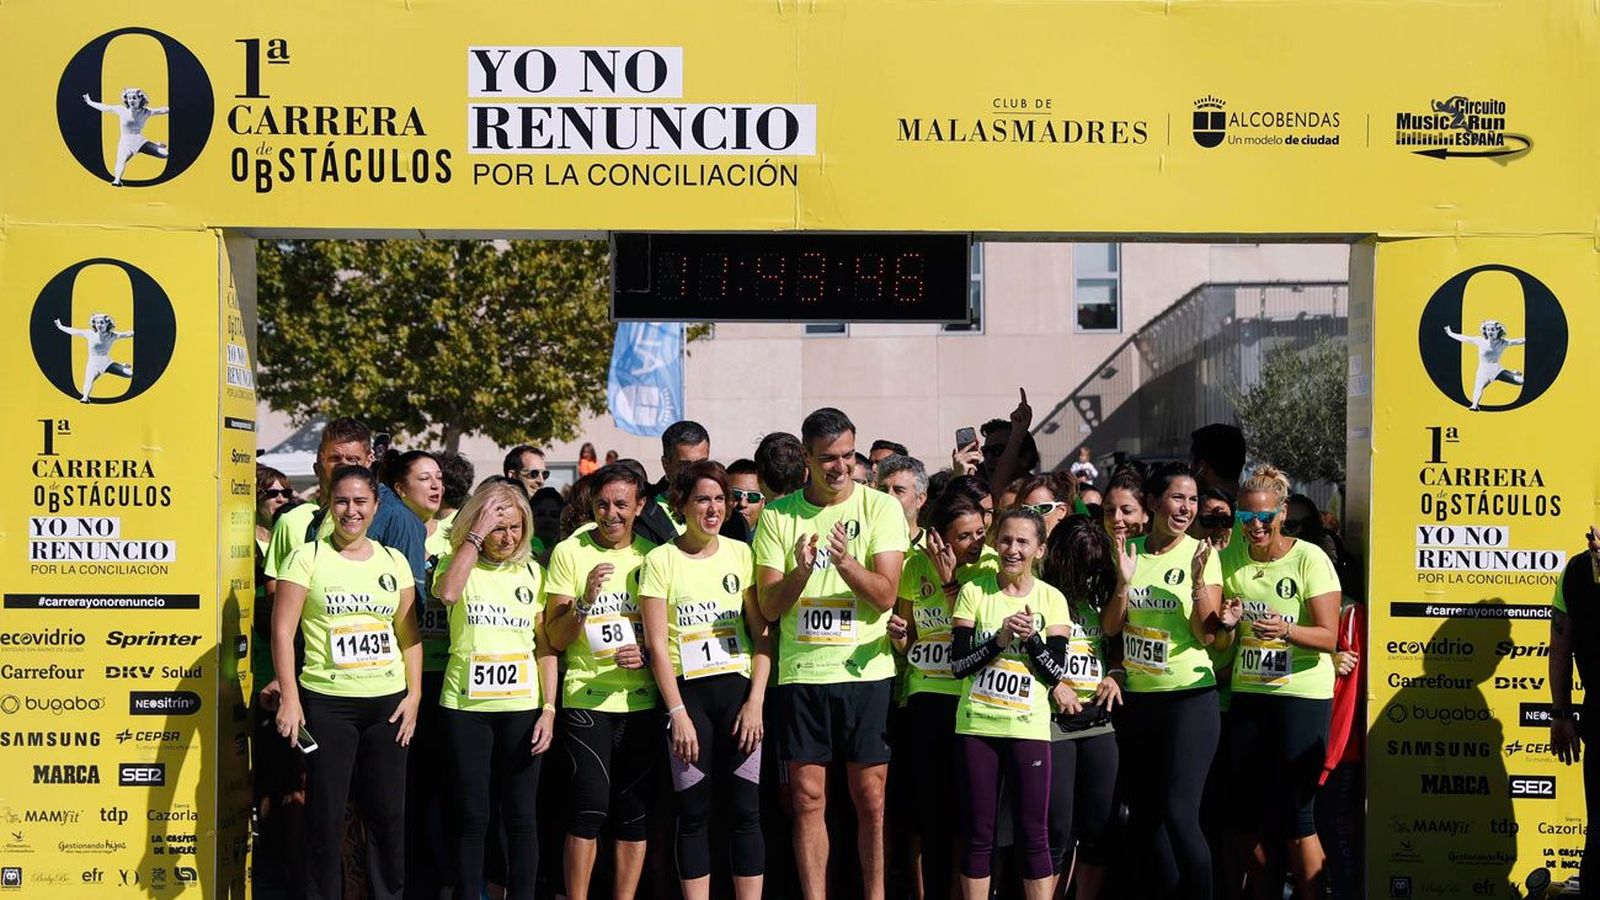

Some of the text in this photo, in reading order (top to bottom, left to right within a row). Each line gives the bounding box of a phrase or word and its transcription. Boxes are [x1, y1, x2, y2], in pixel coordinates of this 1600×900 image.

[470, 49, 668, 93] YO NO
[992, 98, 1052, 109] CLUB DE
[1455, 99, 1506, 115] Circuito
[227, 105, 427, 137] CARRERA
[472, 106, 799, 150] RENUNCIO
[1229, 112, 1340, 128] ALCOBENDAS
[896, 118, 1148, 145] MALASMADRES
[1228, 134, 1340, 145] Un modelo de ciudad
[1455, 131, 1504, 146] ESPAÑA
[256, 141, 272, 156] de
[231, 141, 452, 193] OBSTÁCULOS
[473, 158, 798, 187] POR LA CONCILIACIÓN
[32, 459, 155, 478] CARRERA
[1419, 467, 1545, 487] CARRERA
[33, 481, 171, 514] OBSTÁCULOS
[1421, 490, 1561, 522] OBSTÁCULOS
[31, 518, 114, 537] YO NO
[1418, 526, 1502, 545] YO NO
[31, 541, 169, 561] RENUNCIO
[1418, 550, 1558, 570] RENUNCIO
[31, 563, 169, 575] POR LA CONCILIACIÓN
[1417, 572, 1558, 586] POR LA CONCILIACIÓN
[38, 596, 165, 609] #carrerayonorenuncio
[325, 592, 370, 604] YO NO
[612, 592, 630, 602] NO
[1129, 599, 1177, 609] NUNCIO
[326, 605, 394, 616] RENUNCIO
[467, 603, 506, 615] YO NO
[676, 600, 717, 615] YO NO
[467, 615, 531, 628] RENUNCIO
[803, 609, 833, 630] 100
[1, 628, 85, 646] ecovidrio
[105, 630, 202, 649] Sprinter
[601, 623, 624, 643] 58
[336, 633, 381, 657] 1143
[701, 641, 711, 661] 1
[1125, 635, 1153, 661] 1075
[1387, 637, 1474, 655] ecovidrio
[1240, 649, 1273, 671] 1074
[1, 664, 85, 680] Carrefour
[105, 665, 202, 679] DKV Salud
[474, 664, 517, 685] 5102
[1387, 672, 1473, 689] Carrefour
[978, 668, 1019, 695] 1100
[1494, 677, 1545, 690] DKV
[0, 731, 101, 747] SAMSUNG
[135, 731, 180, 742] CEPSA
[1387, 740, 1490, 757] SAMSUNG
[33, 765, 100, 784] MARCA
[122, 768, 162, 782] SER
[1421, 775, 1490, 795] MARCA
[1512, 780, 1553, 794] SER
[100, 807, 129, 826] tdp
[147, 809, 199, 822] Cazorla
[1491, 818, 1519, 838] tdp
[82, 867, 104, 882] efr
